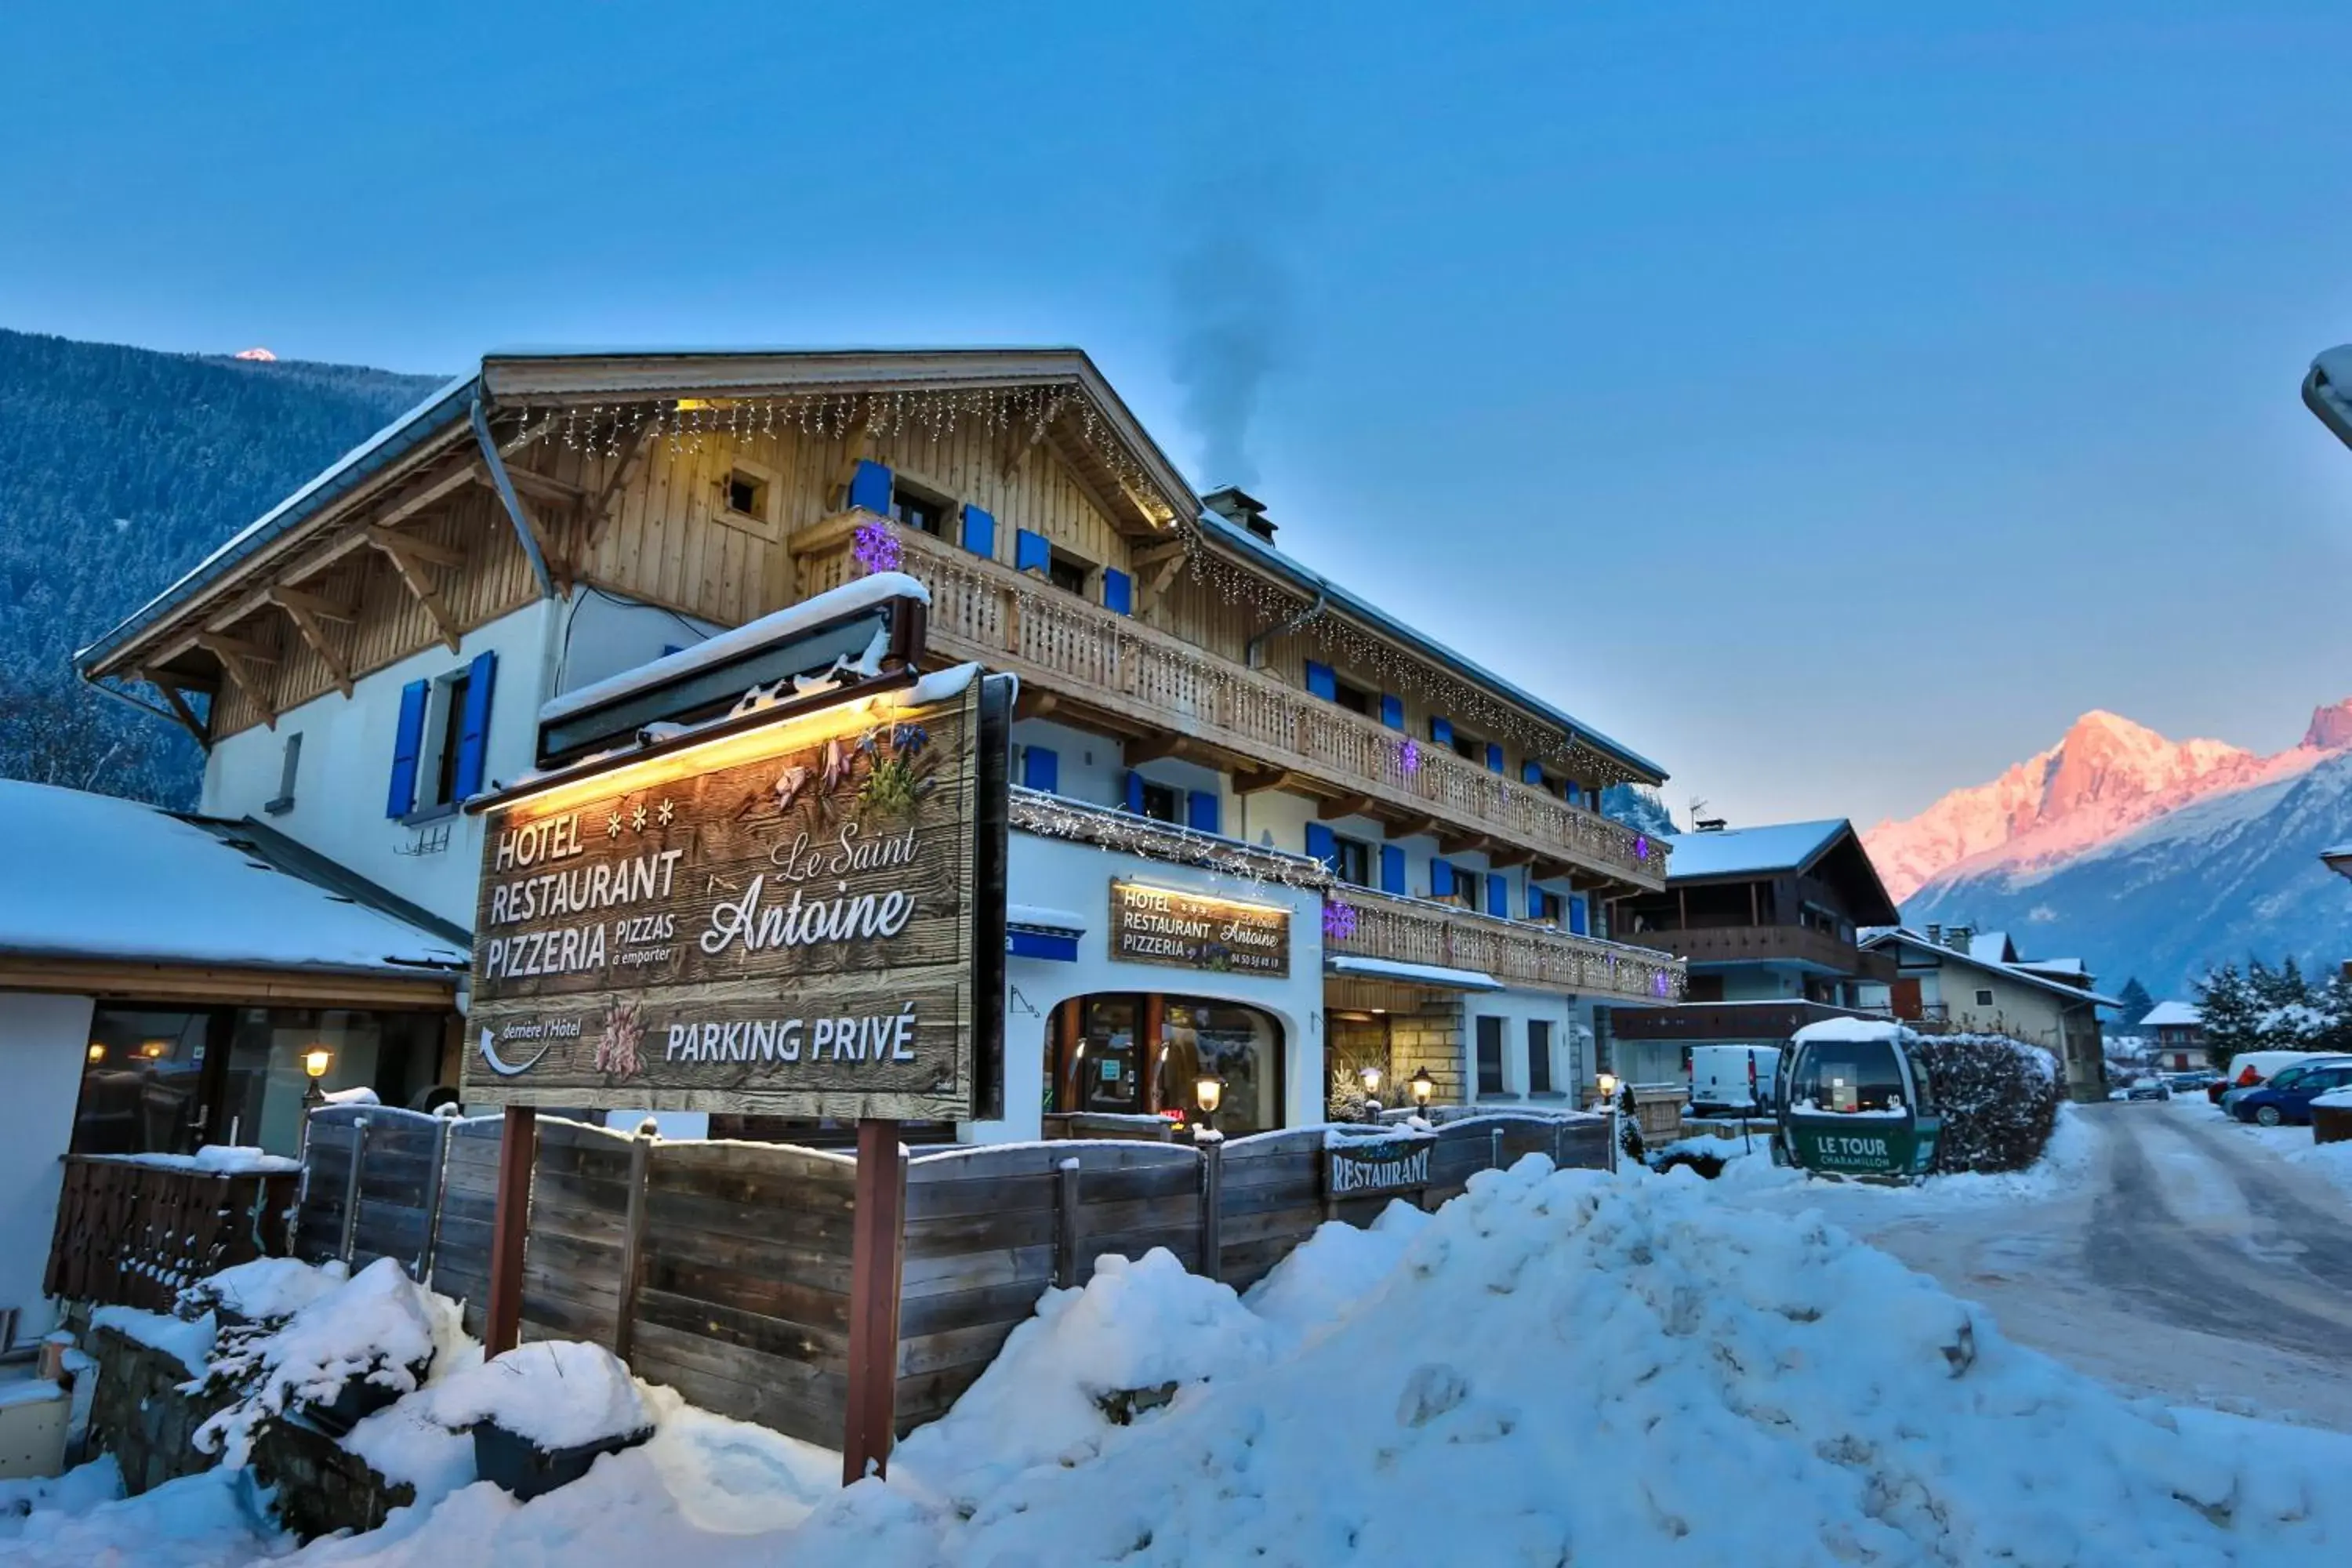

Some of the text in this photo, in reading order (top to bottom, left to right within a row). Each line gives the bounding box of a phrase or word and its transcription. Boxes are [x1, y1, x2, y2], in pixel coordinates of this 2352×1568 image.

[495, 812, 583, 872] HOTEL
[771, 822, 920, 881] Le Saint
[491, 849, 683, 925] RESTAURANT
[1123, 890, 1171, 913] HOTEL
[615, 913, 675, 944] PIZZAS
[700, 873, 915, 953] Antoine
[1123, 911, 1211, 939] RESTAURANT
[1123, 934, 1185, 957] PIZZERIA
[1220, 919, 1279, 948] Antoine
[486, 923, 605, 979] PIZZERIA
[622, 948, 670, 968] emporter
[503, 1018, 582, 1039] derrière l'Hôtel
[666, 1000, 916, 1061] PARKING PRIVÉ
[1817, 1137, 1887, 1156] LE TOUR
[1333, 1147, 1430, 1192] RESTAURANT
